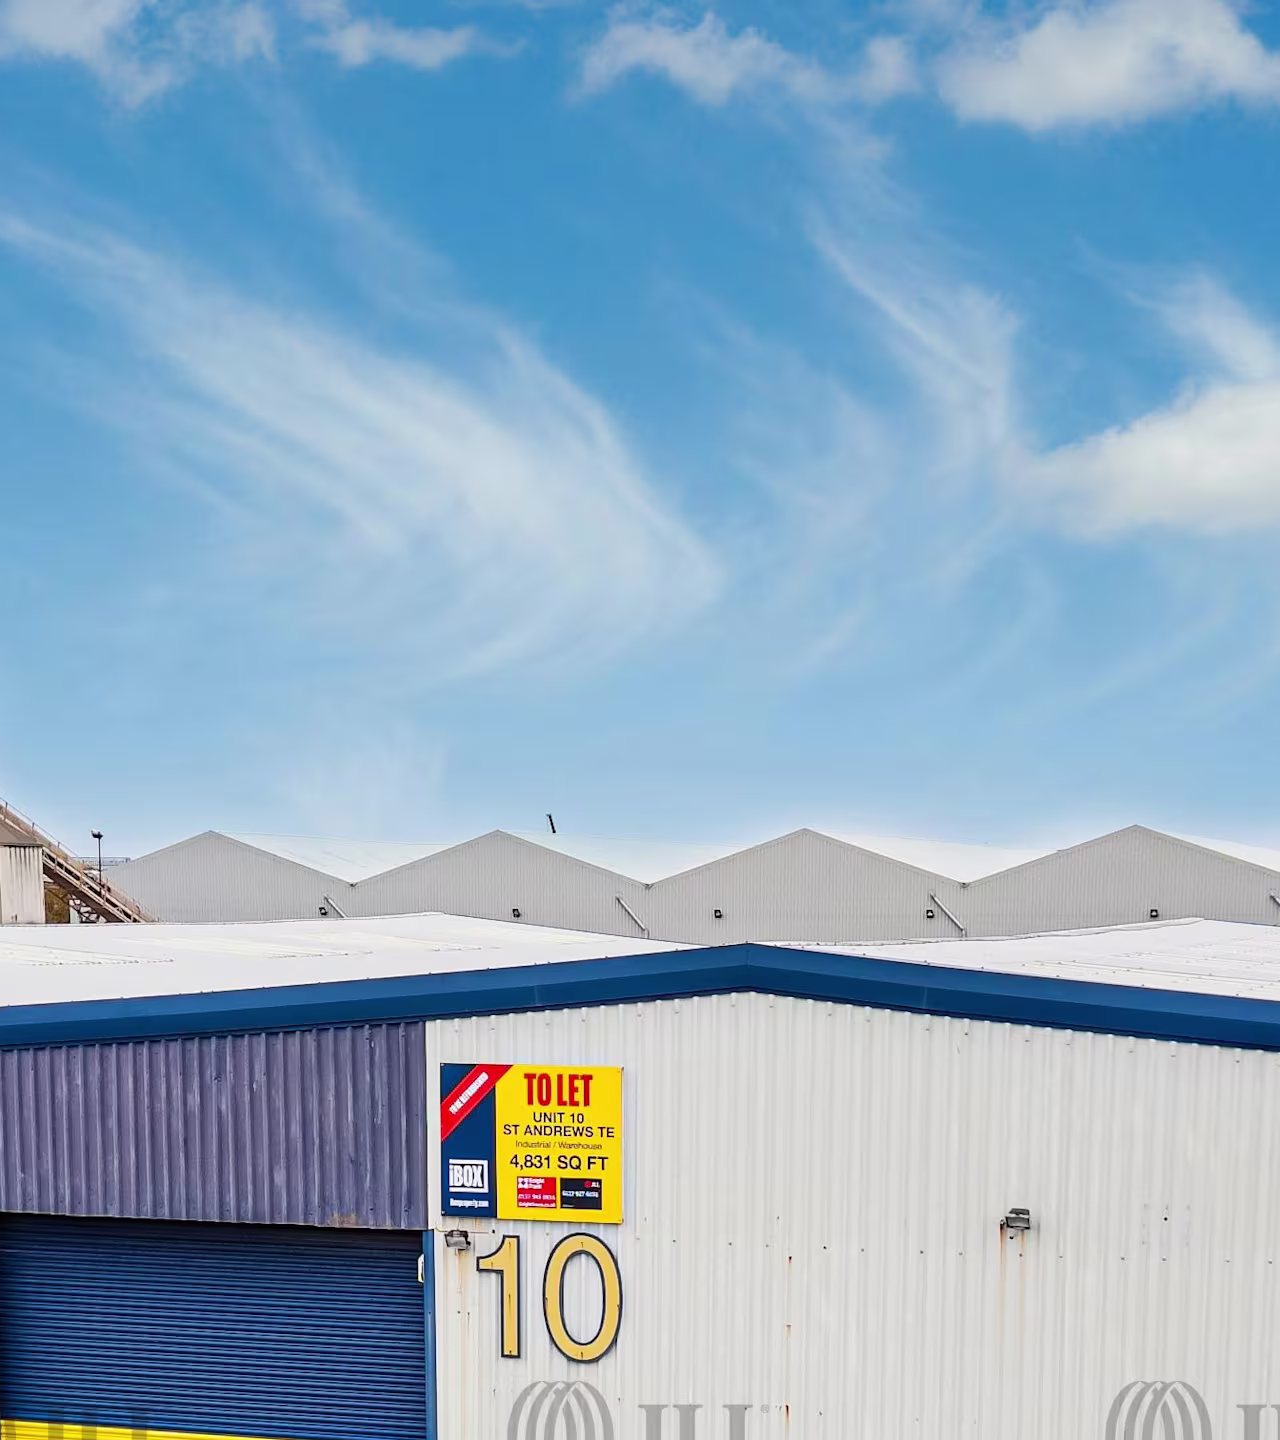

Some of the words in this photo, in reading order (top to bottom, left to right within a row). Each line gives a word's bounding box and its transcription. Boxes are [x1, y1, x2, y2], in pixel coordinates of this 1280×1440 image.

[524, 1073, 552, 1107] TO
[557, 1074, 594, 1107] LET
[533, 1112, 566, 1123] UNIT
[570, 1113, 585, 1124] 10
[503, 1124, 520, 1136] ST
[524, 1125, 594, 1137] ANDREWS
[598, 1127, 615, 1138] TE
[515, 1140, 551, 1149] Industrial
[558, 1142, 603, 1150] Warehouse
[510, 1154, 551, 1171] 4,831
[557, 1155, 582, 1170] SQ
[587, 1156, 609, 1170] FT
[476, 1232, 623, 1363] 10
